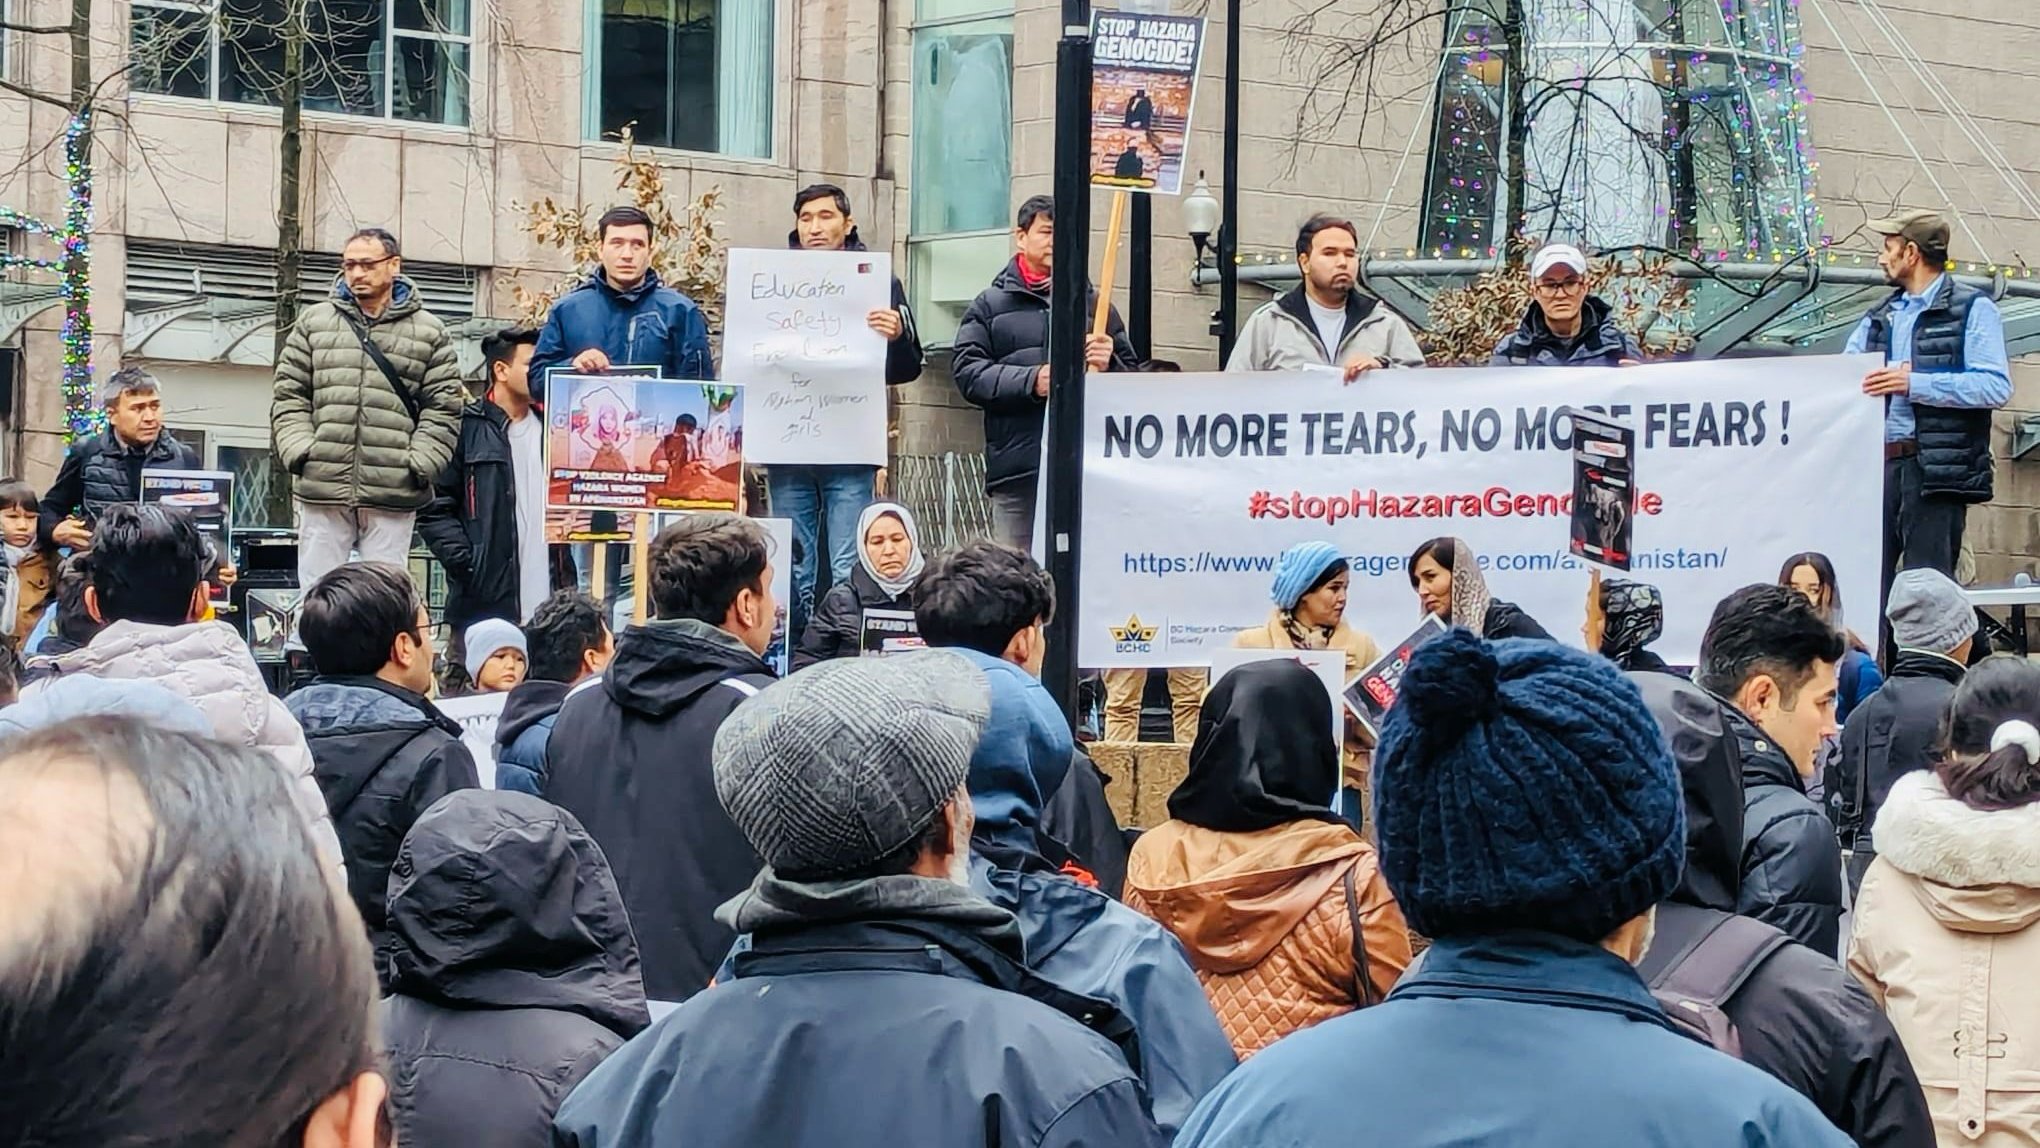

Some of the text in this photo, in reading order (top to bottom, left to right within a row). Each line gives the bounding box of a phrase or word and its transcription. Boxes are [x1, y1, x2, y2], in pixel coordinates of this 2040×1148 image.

[1098, 18, 1195, 41] STOP HAZARA
[1094, 36, 1195, 64] GENOCIDE!
[751, 272, 845, 300] Education
[765, 309, 841, 336] Safety
[1104, 414, 1163, 458] NO
[1175, 413, 1288, 457] MORE
[1300, 411, 1427, 459] TEARS,
[1440, 408, 1501, 451] NO
[1514, 405, 1631, 450] MO
[1645, 400, 1766, 448] FEARS
